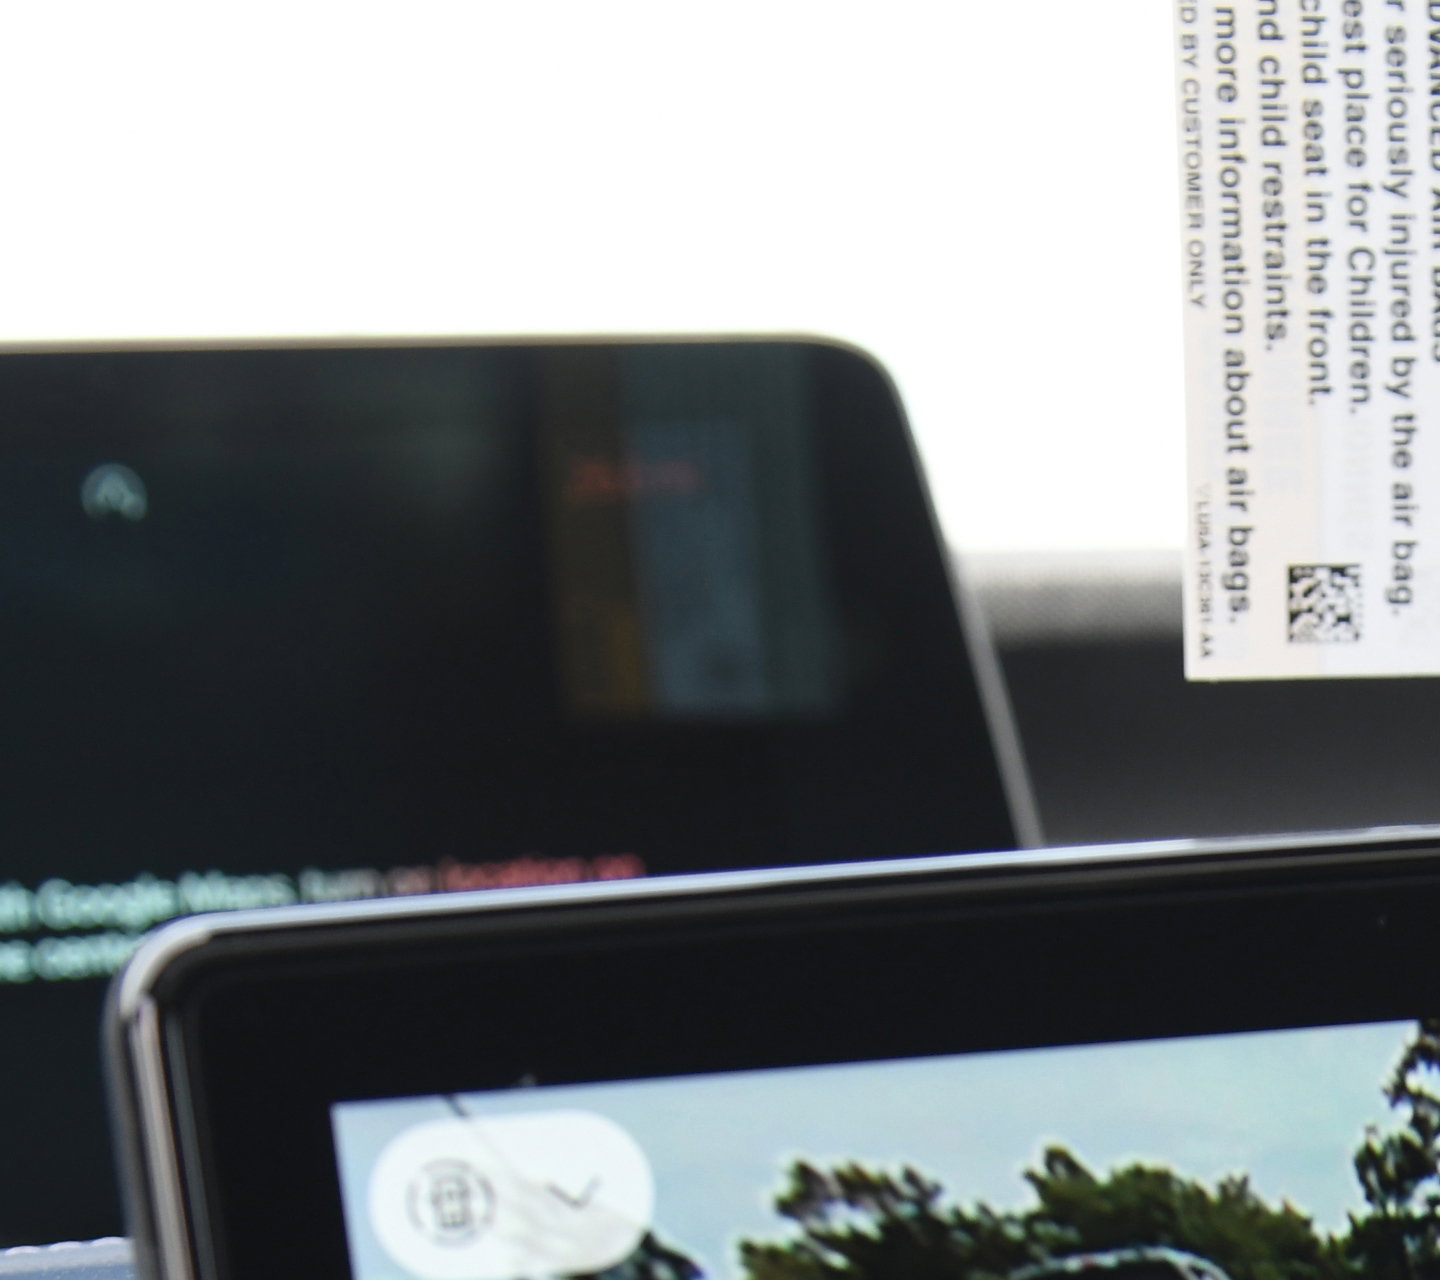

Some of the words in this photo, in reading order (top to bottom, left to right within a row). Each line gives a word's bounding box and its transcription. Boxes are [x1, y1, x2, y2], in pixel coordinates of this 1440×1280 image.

[1181, 35, 1198, 67] BY
[1215, 8, 1240, 102] more
[1343, 0, 1369, 52] est
[1261, 56, 1286, 145] child
[1304, 100, 1327, 176] seat
[1338, 69, 1374, 167] place
[1381, 26, 1413, 198] seriously
[1183, 79, 1202, 228] CUSTOMER
[1218, 118, 1246, 333] information
[1305, 192, 1329, 222] in
[1348, 183, 1374, 232] for
[1187, 240, 1206, 308] ONLY
[1262, 162, 1291, 353] restraints.
[1306, 239, 1331, 292] the
[1383, 214, 1415, 340] injured
[1306, 309, 1333, 405] front.
[1348, 247, 1378, 414] Children.
[1224, 348, 1252, 452] about
[1386, 357, 1415, 399] by
[1392, 414, 1416, 467] the
[1228, 468, 1252, 511] air
[1392, 483, 1415, 525] air
[1224, 526, 1253, 622] bags.
[1388, 542, 1417, 615] bag.
